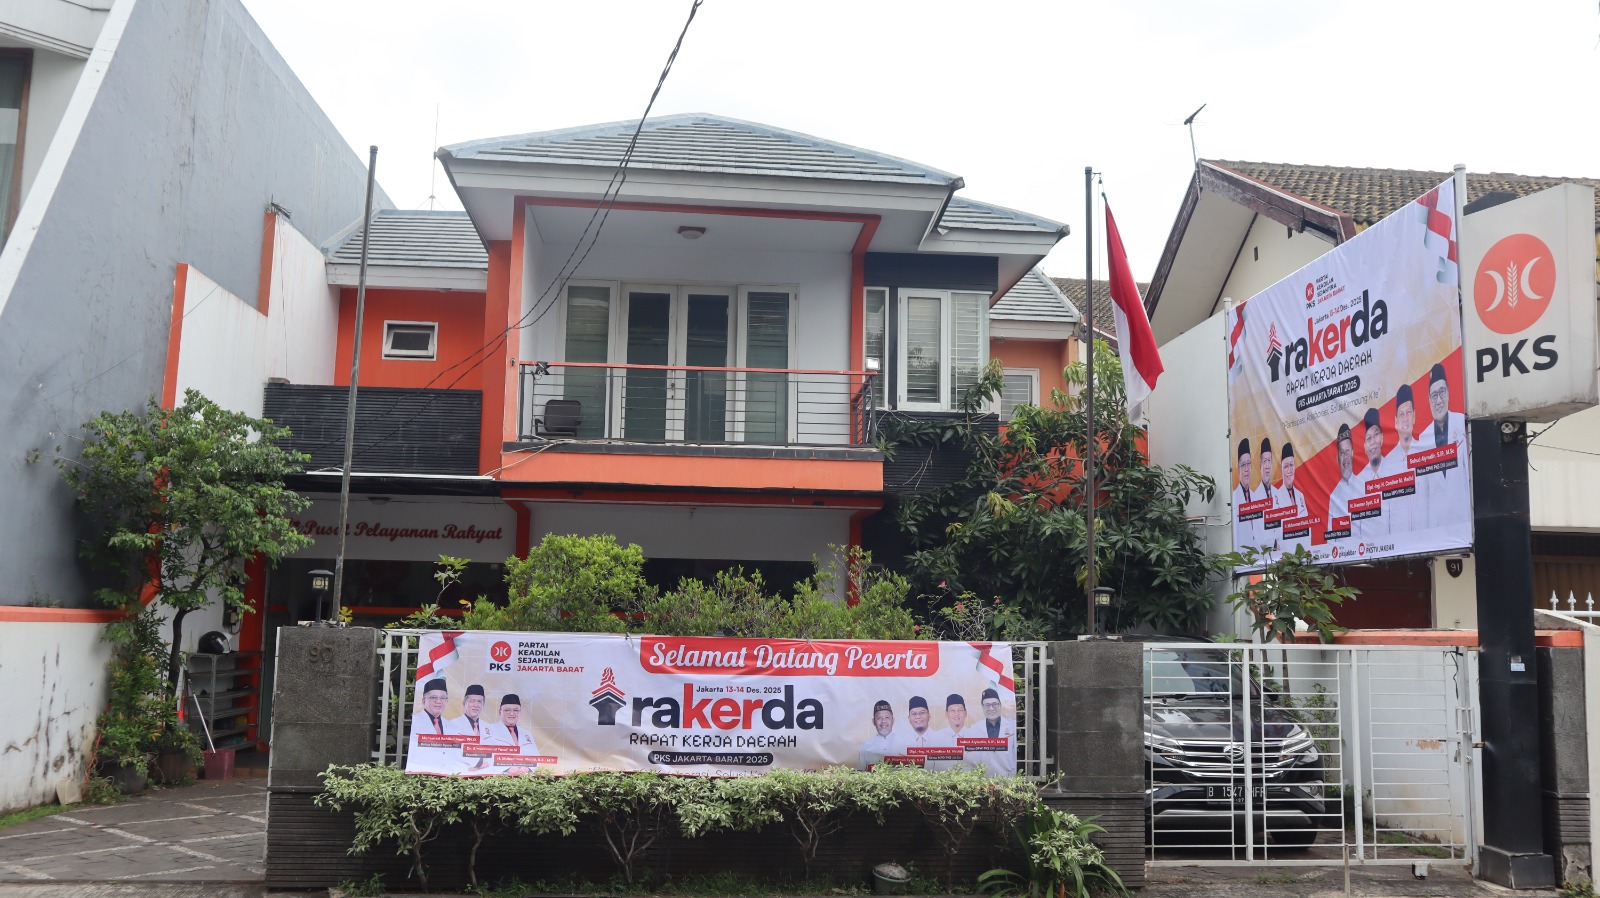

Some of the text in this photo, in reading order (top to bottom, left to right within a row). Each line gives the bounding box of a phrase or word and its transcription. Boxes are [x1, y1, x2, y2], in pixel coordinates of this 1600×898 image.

[1285, 289, 1389, 377] rakerda
[1476, 335, 1559, 383] PKS
[1286, 348, 1373, 396] RAPAT KERJA DAERAH
[1306, 390, 1328, 405] JAKARTA
[1344, 379, 1358, 392] 2025
[353, 521, 439, 542] Pelayanan
[441, 523, 503, 544] Rakyat
[1450, 563, 1461, 572] 91
[489, 663, 511, 671] PKS
[517, 657, 565, 665] SEJAHTERA
[649, 642, 928, 676] Selamat Datang Peserta
[631, 683, 824, 730] rakerda
[629, 733, 797, 748] RAPAT KERJA DAERAH
[653, 754, 768, 764] PKS JAKARTA BARAT 2025
[1208, 786, 1214, 797] B
[1222, 786, 1243, 797] 1547
